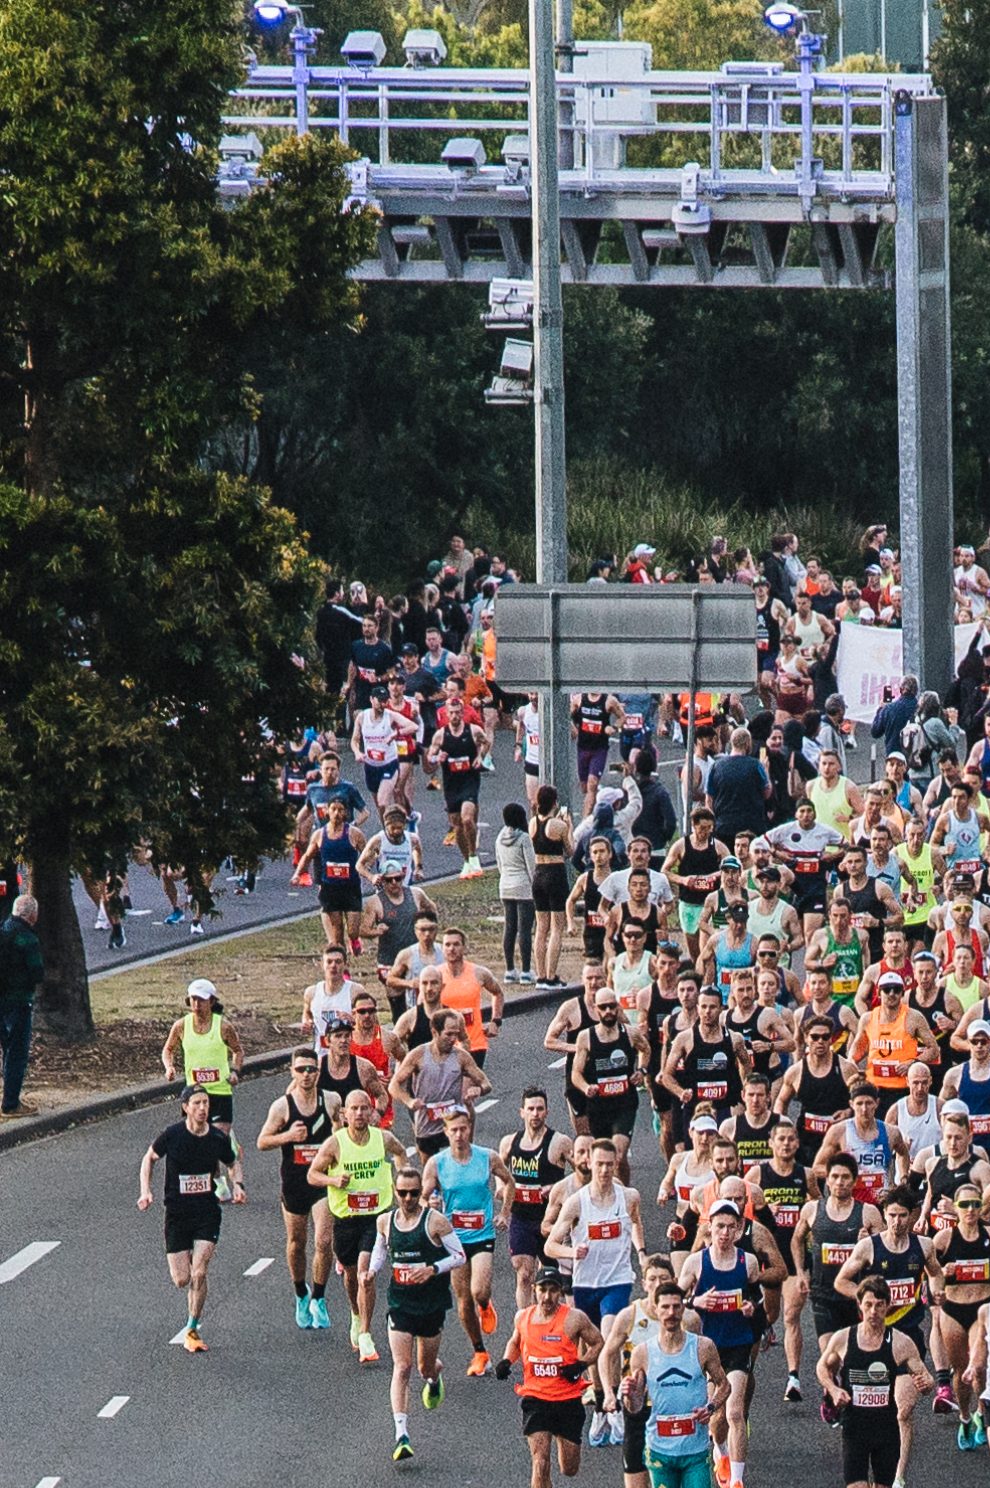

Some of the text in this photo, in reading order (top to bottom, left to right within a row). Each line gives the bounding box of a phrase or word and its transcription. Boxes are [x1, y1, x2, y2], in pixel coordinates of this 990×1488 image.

[353, 1170, 377, 1181] CREW
[184, 1179, 208, 1192] 12351
[858, 1393, 887, 1406] 12908
